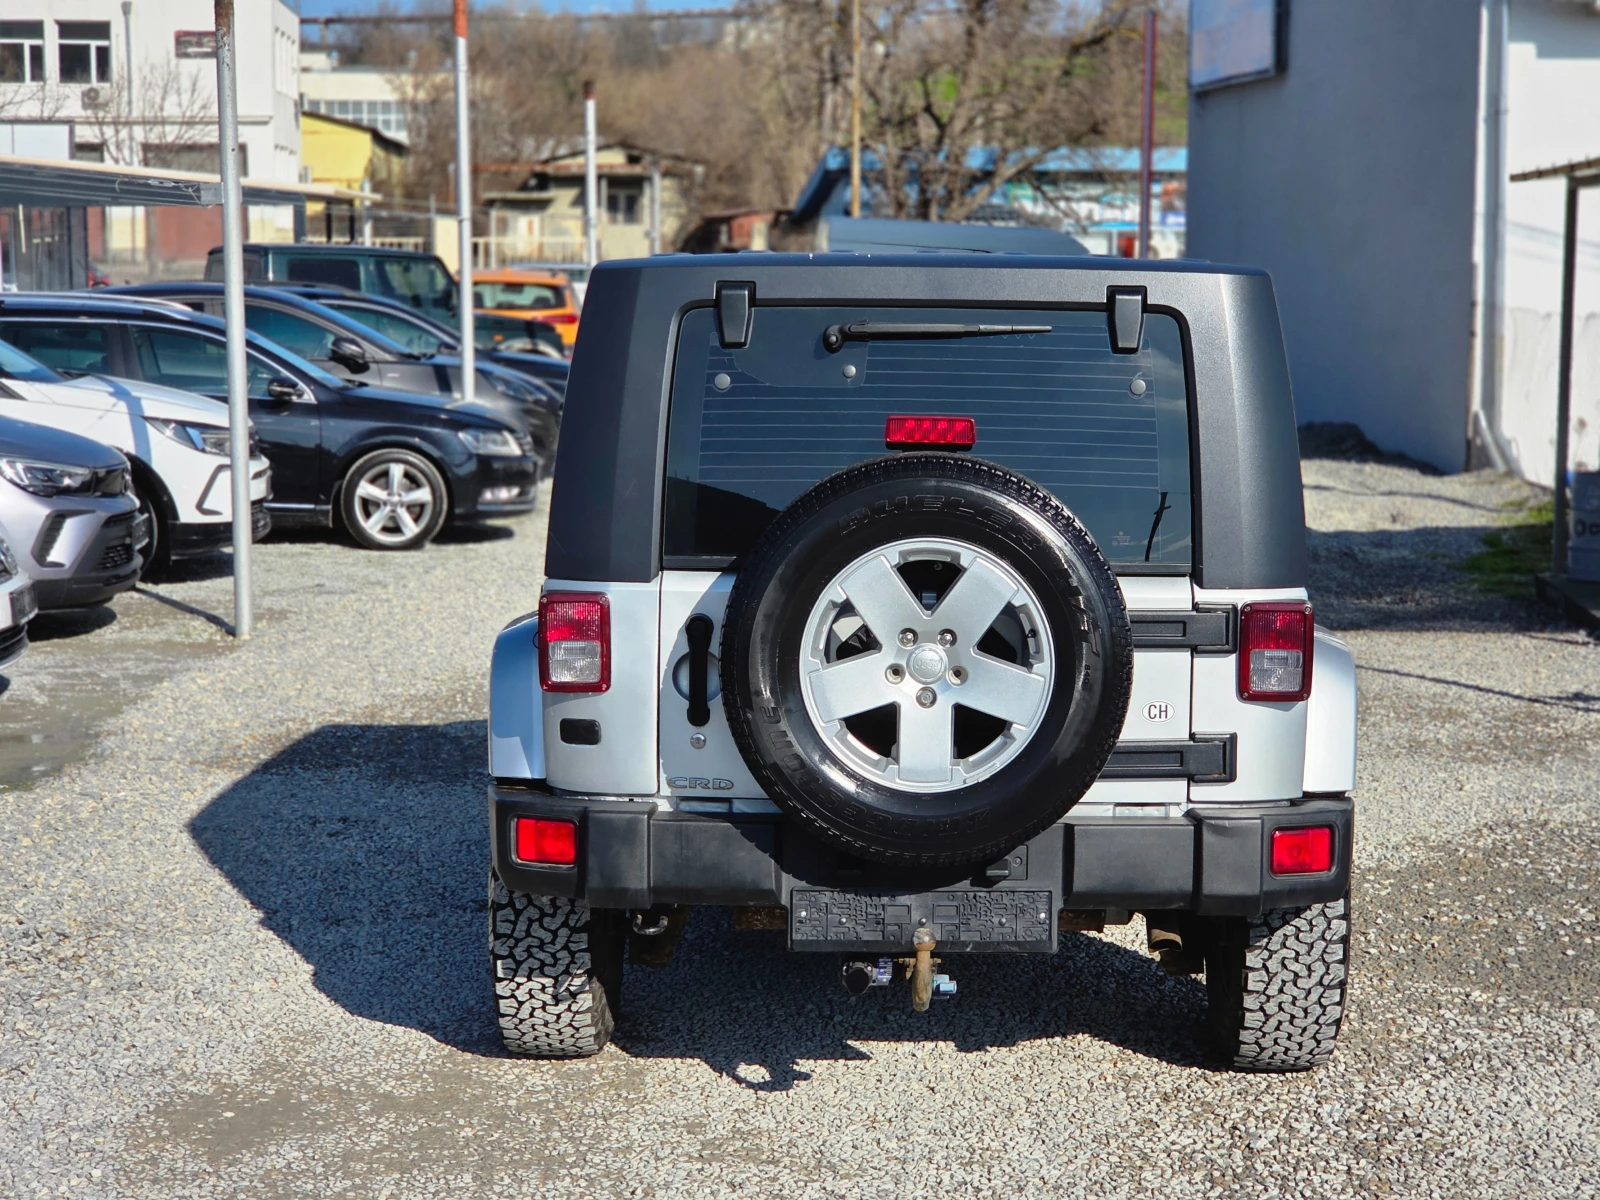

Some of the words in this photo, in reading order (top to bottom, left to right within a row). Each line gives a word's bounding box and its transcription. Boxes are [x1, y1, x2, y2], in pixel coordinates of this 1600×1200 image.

[838, 493, 1044, 551] DUELER
[1083, 662, 1092, 686] 840
[915, 658, 940, 672] Jeep
[1147, 704, 1169, 720] CH
[667, 776, 734, 790] CRD
